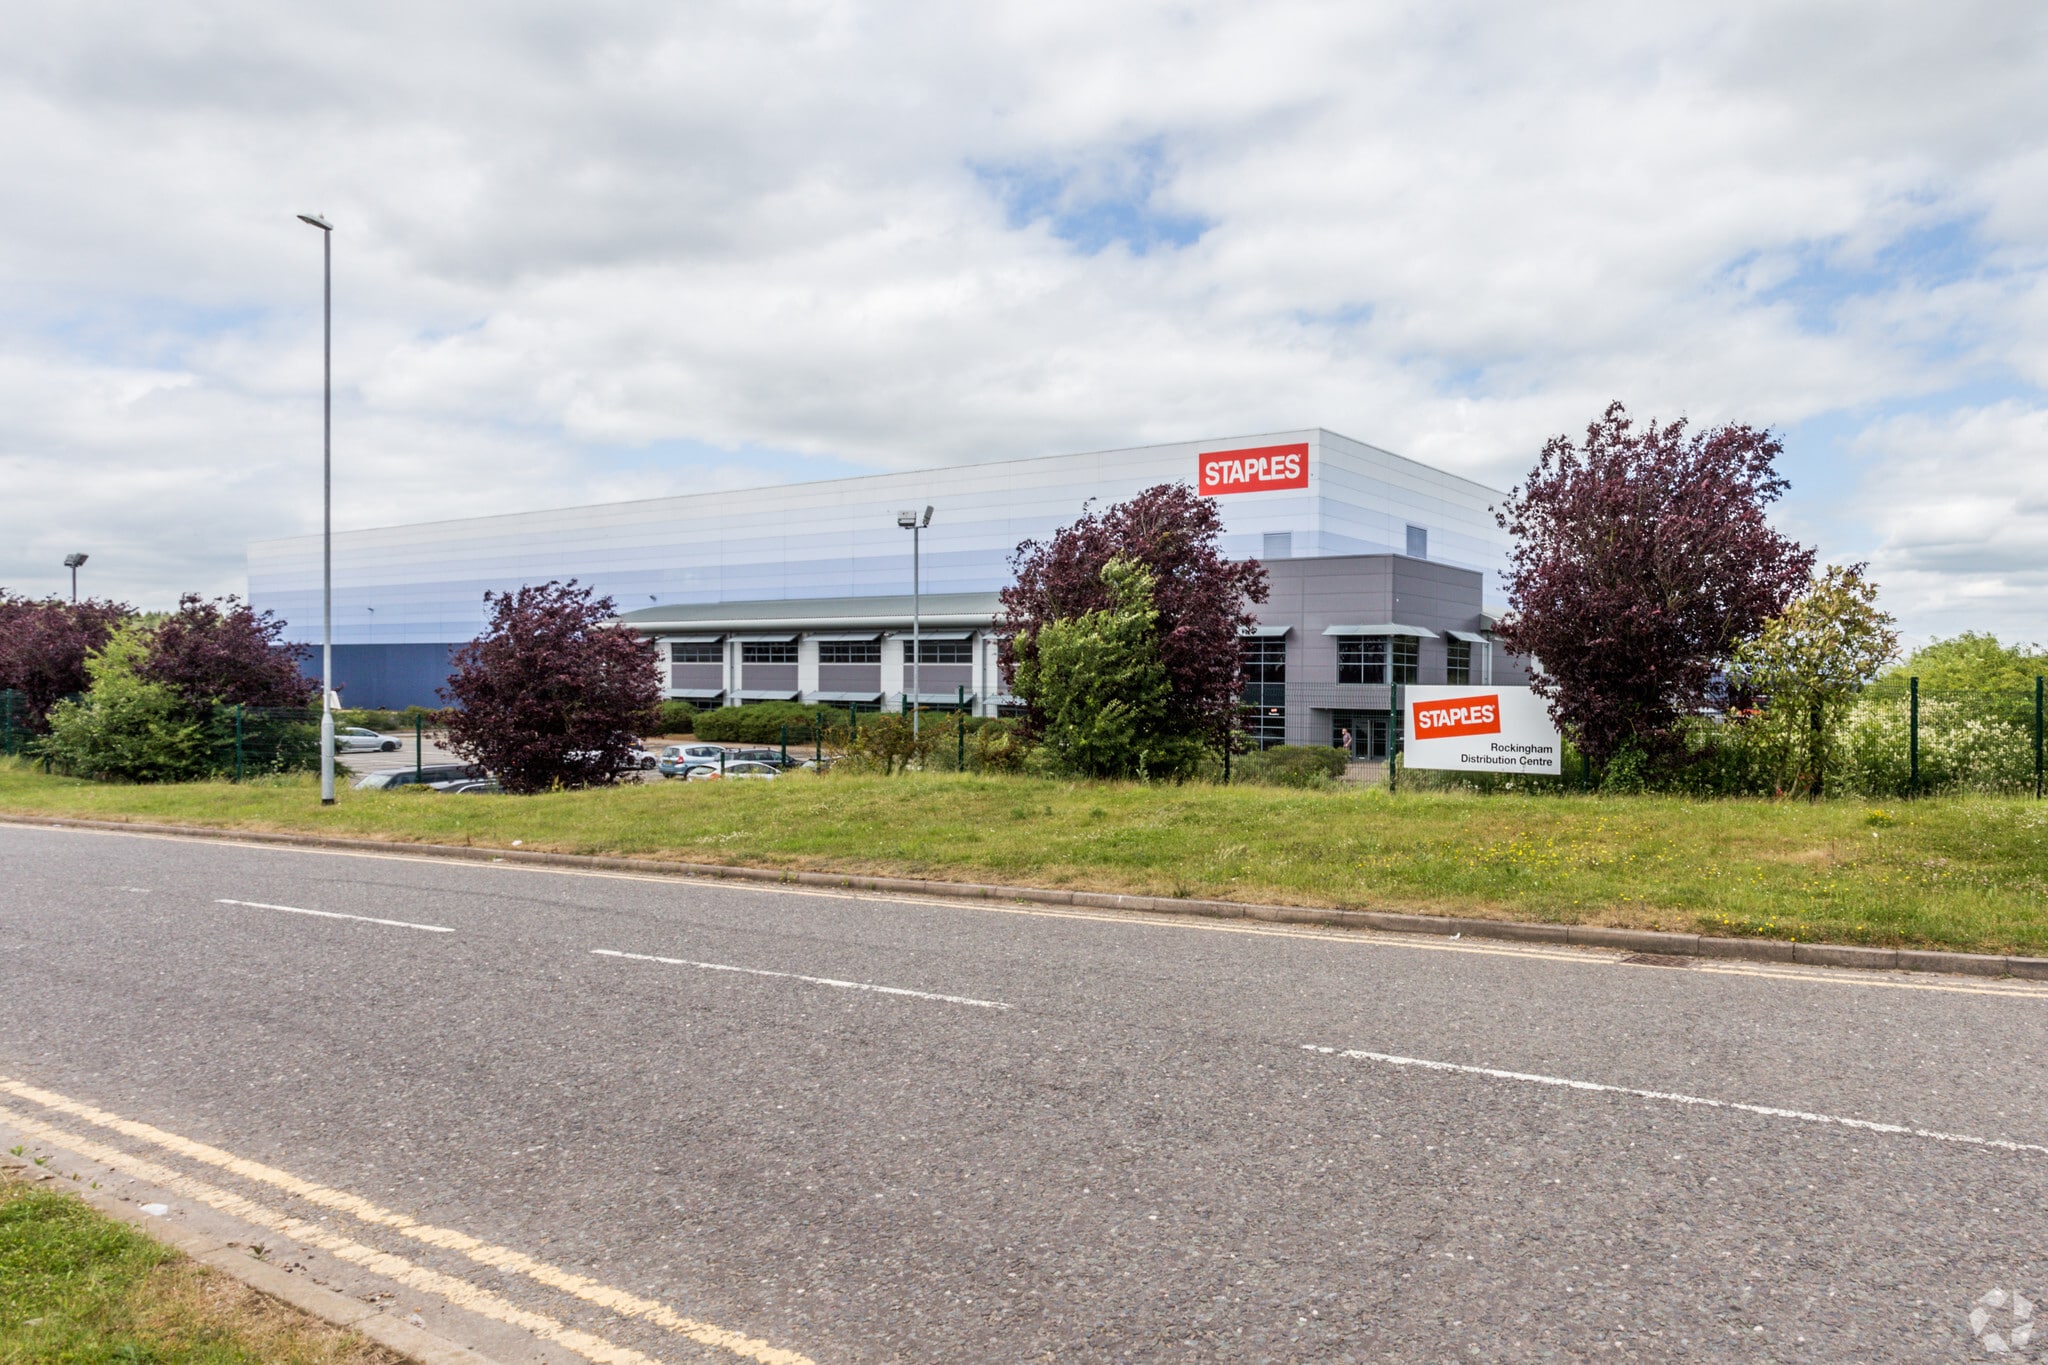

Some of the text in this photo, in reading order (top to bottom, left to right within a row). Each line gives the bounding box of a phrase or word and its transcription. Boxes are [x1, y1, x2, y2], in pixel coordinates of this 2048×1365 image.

[1205, 454, 1301, 486] STAPLES
[1419, 705, 1495, 728] STAPLES
[1490, 742, 1553, 755] Rockingham
[1461, 753, 1553, 767] Distribution Centre
